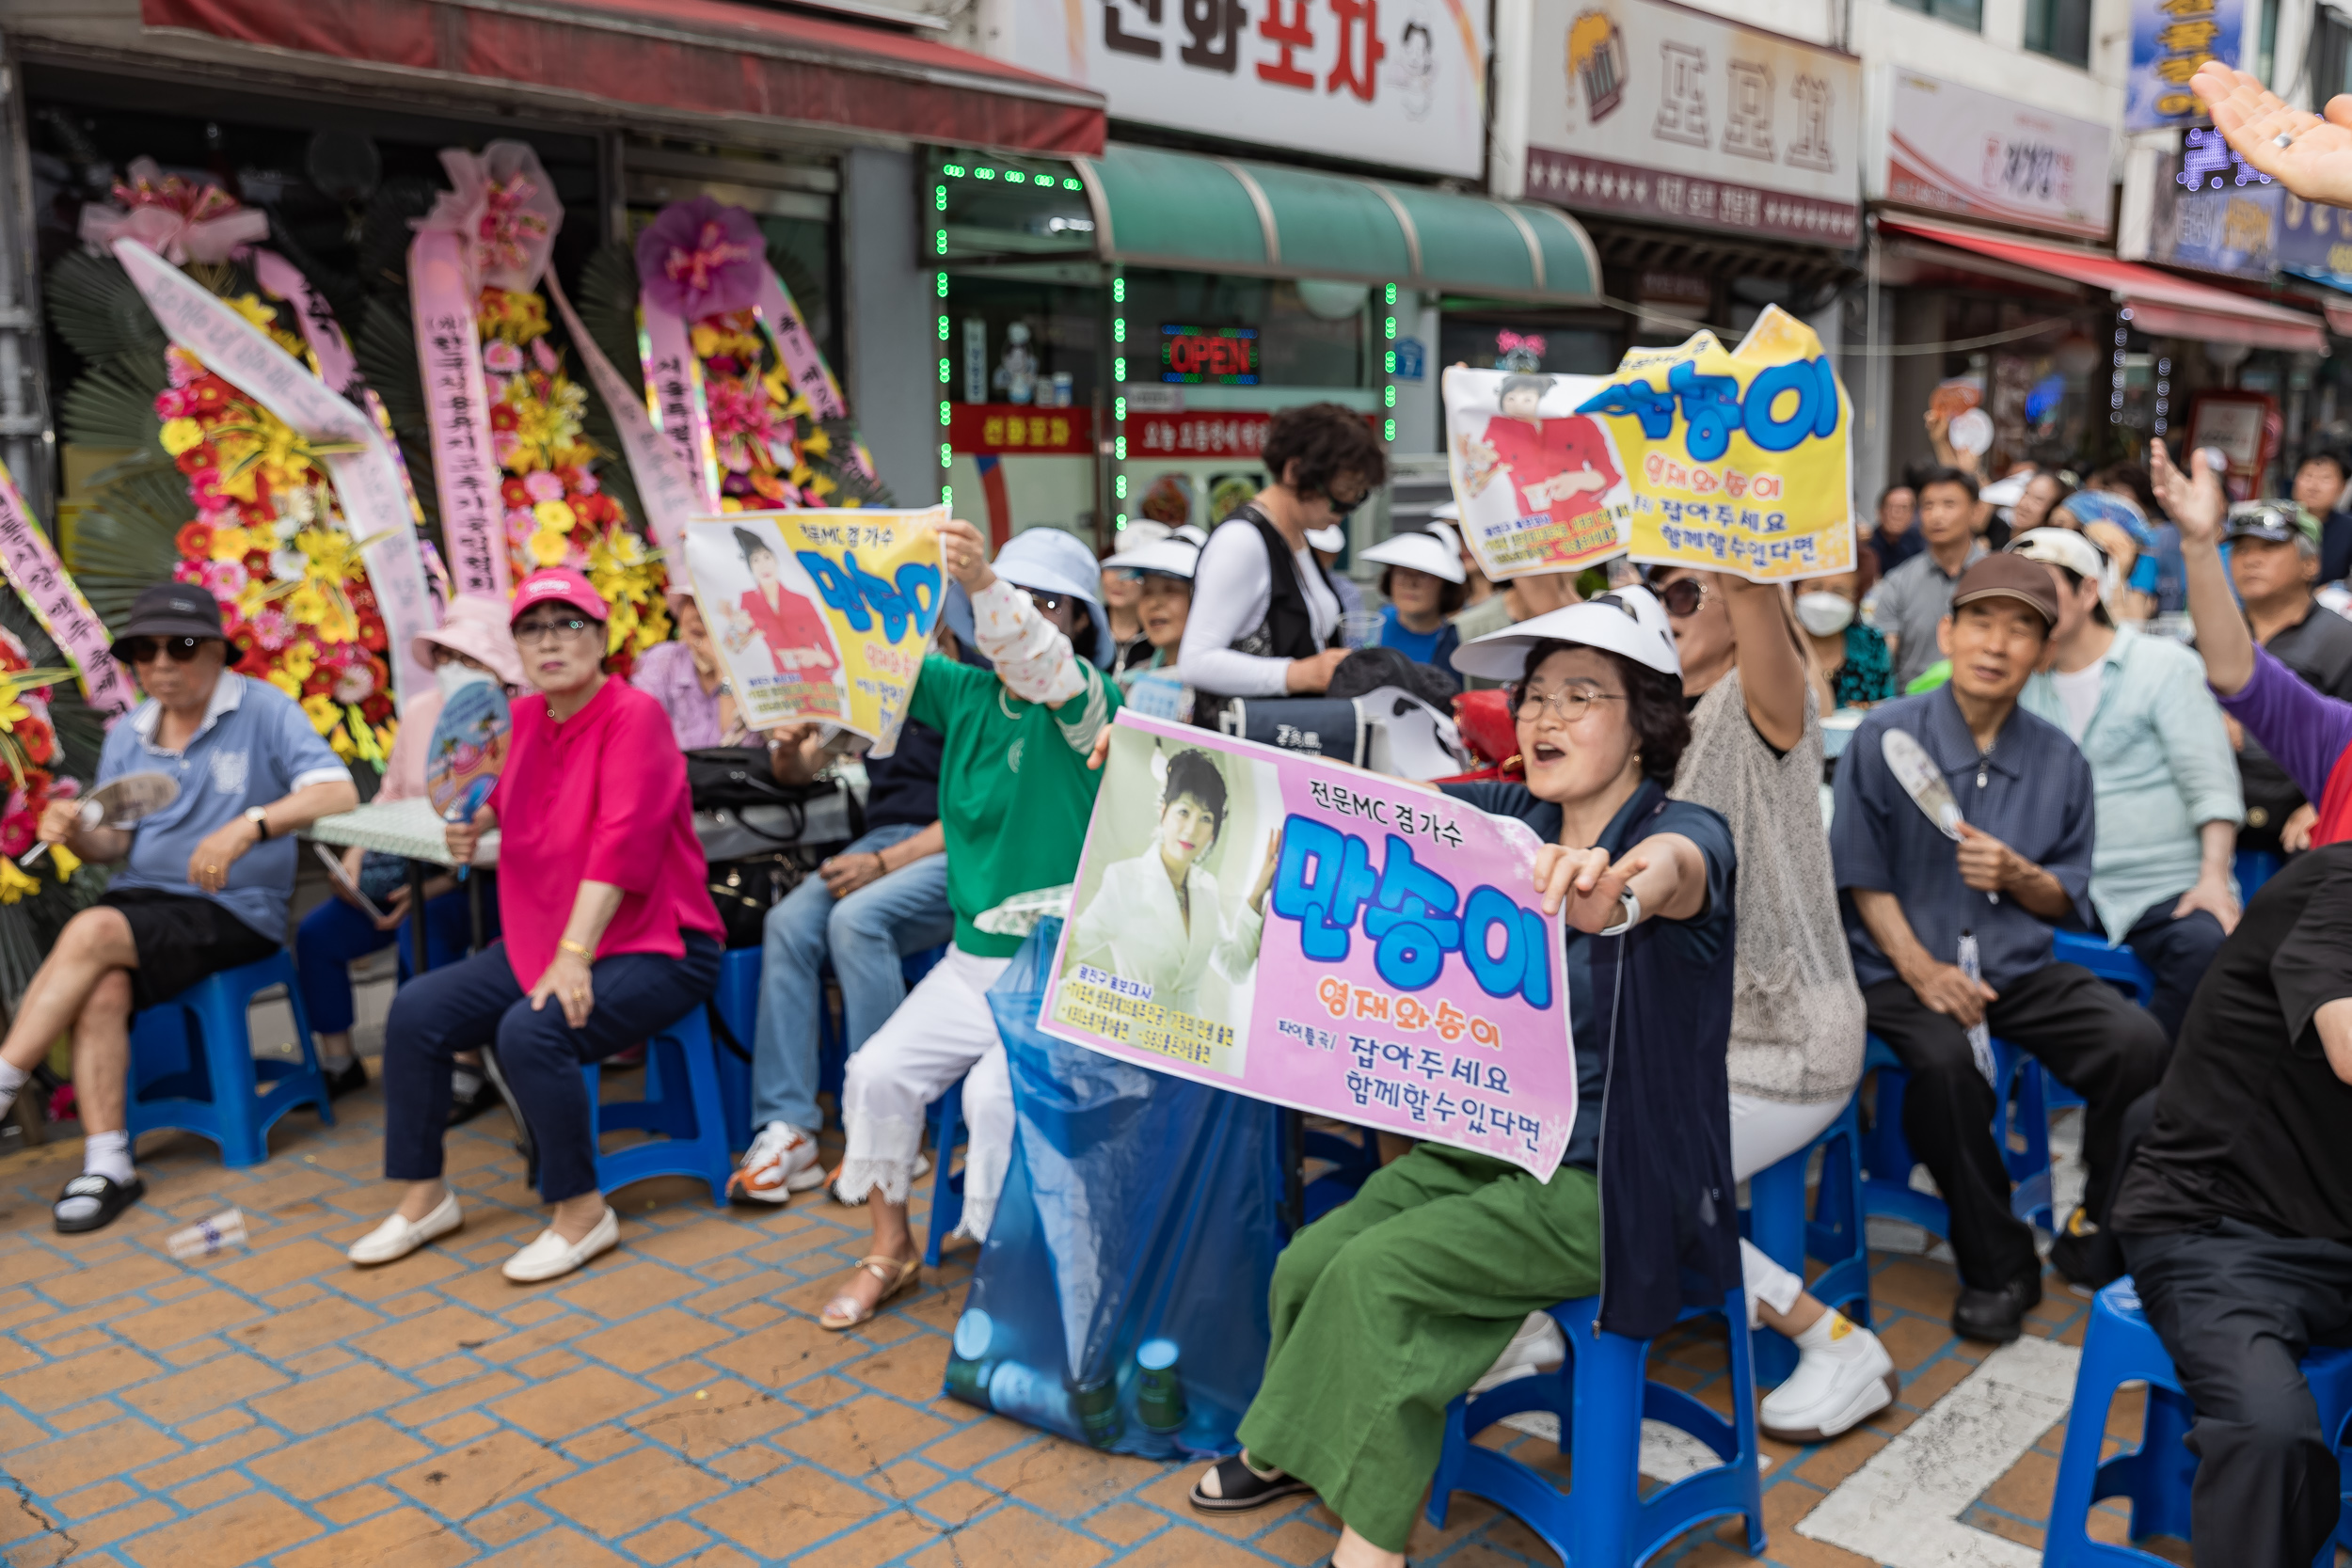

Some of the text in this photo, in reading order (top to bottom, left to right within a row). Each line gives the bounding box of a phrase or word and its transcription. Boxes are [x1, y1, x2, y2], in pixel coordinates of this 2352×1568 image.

[1170, 335, 1250, 374] OPEN
[1310, 780, 1389, 825] 전문MC
[1273, 813, 1552, 1010] 만송이
[1349, 1035, 1510, 1095] 잡아주세요
[1346, 1071, 1540, 1153] 함께할수있다면
